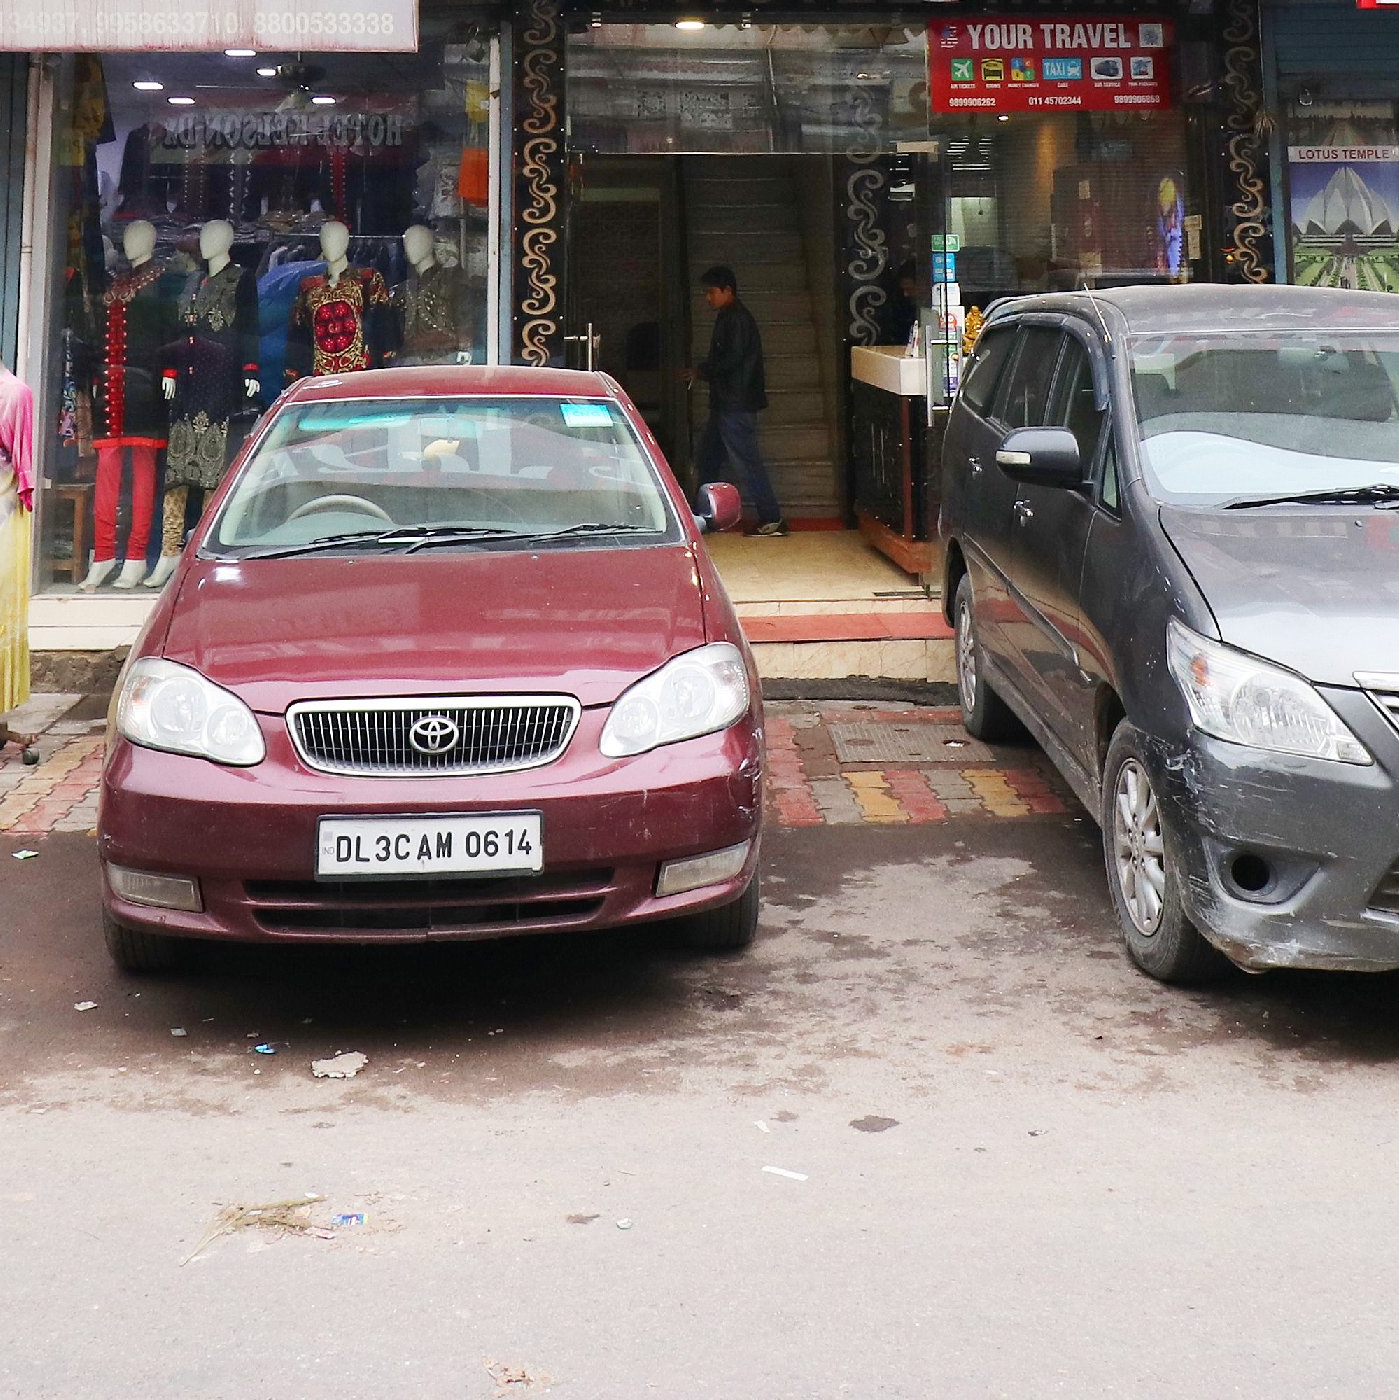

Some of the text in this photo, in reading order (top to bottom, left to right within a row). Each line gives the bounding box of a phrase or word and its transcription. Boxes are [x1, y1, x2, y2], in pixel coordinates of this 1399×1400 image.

[966, 23, 1132, 49] YOUR TRAVEL
[1043, 61, 1066, 77] TAXI
[1298, 149, 1390, 160] LOTUS TEMPLE
[336, 831, 453, 863] DL3CAM
[465, 828, 533, 858] 0614
